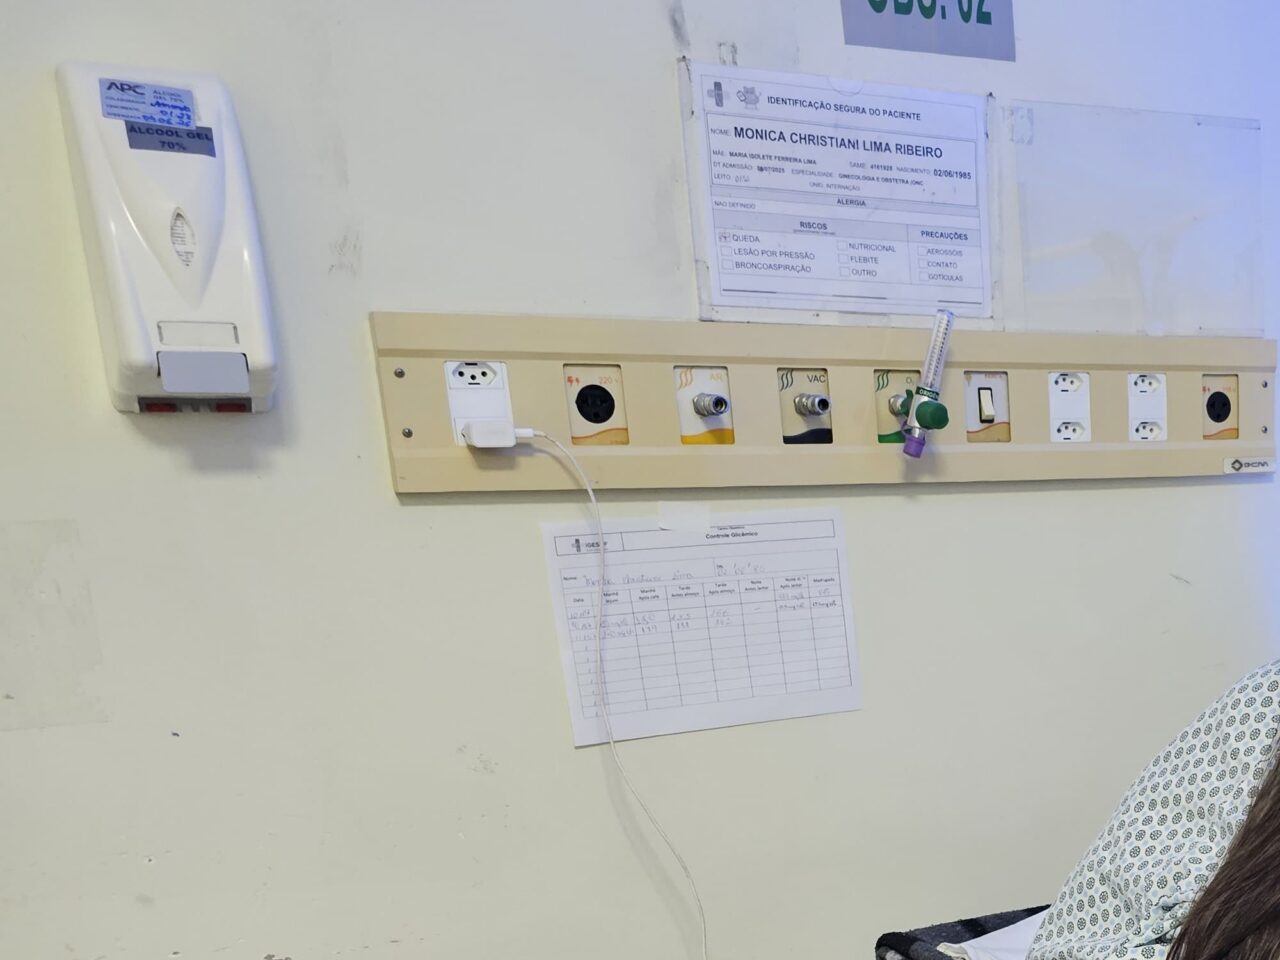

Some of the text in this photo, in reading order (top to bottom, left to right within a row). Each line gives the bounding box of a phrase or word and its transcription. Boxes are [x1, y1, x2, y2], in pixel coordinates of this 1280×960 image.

[767, 96, 921, 121] IDENTIFICAÇÃO SEGURA DO PACIENTE
[186, 132, 214, 141] GEL
[159, 140, 187, 151] 70%
[733, 126, 787, 143] MONICA
[790, 132, 859, 150] CHRISTIANI
[862, 140, 893, 154] LIMA
[895, 143, 943, 159] RIBEIRO
[729, 151, 749, 160] MARIA
[933, 168, 972, 180] 02/06/1985
[837, 198, 867, 207] ALERGIA
[799, 221, 828, 231] RISCOS
[732, 234, 761, 243] QUEDA
[920, 230, 969, 241] PRECAUÇÕES
[848, 242, 896, 253] NUTRICIONAL
[733, 247, 816, 261] LESÃO POR PRESSÃO
[850, 255, 879, 265] FLEBITE
[735, 260, 812, 274] BRONCOASPIRAÇÃO
[927, 261, 958, 270] CONTATO
[851, 268, 878, 278] OUTRO
[807, 374, 826, 384] VAC
